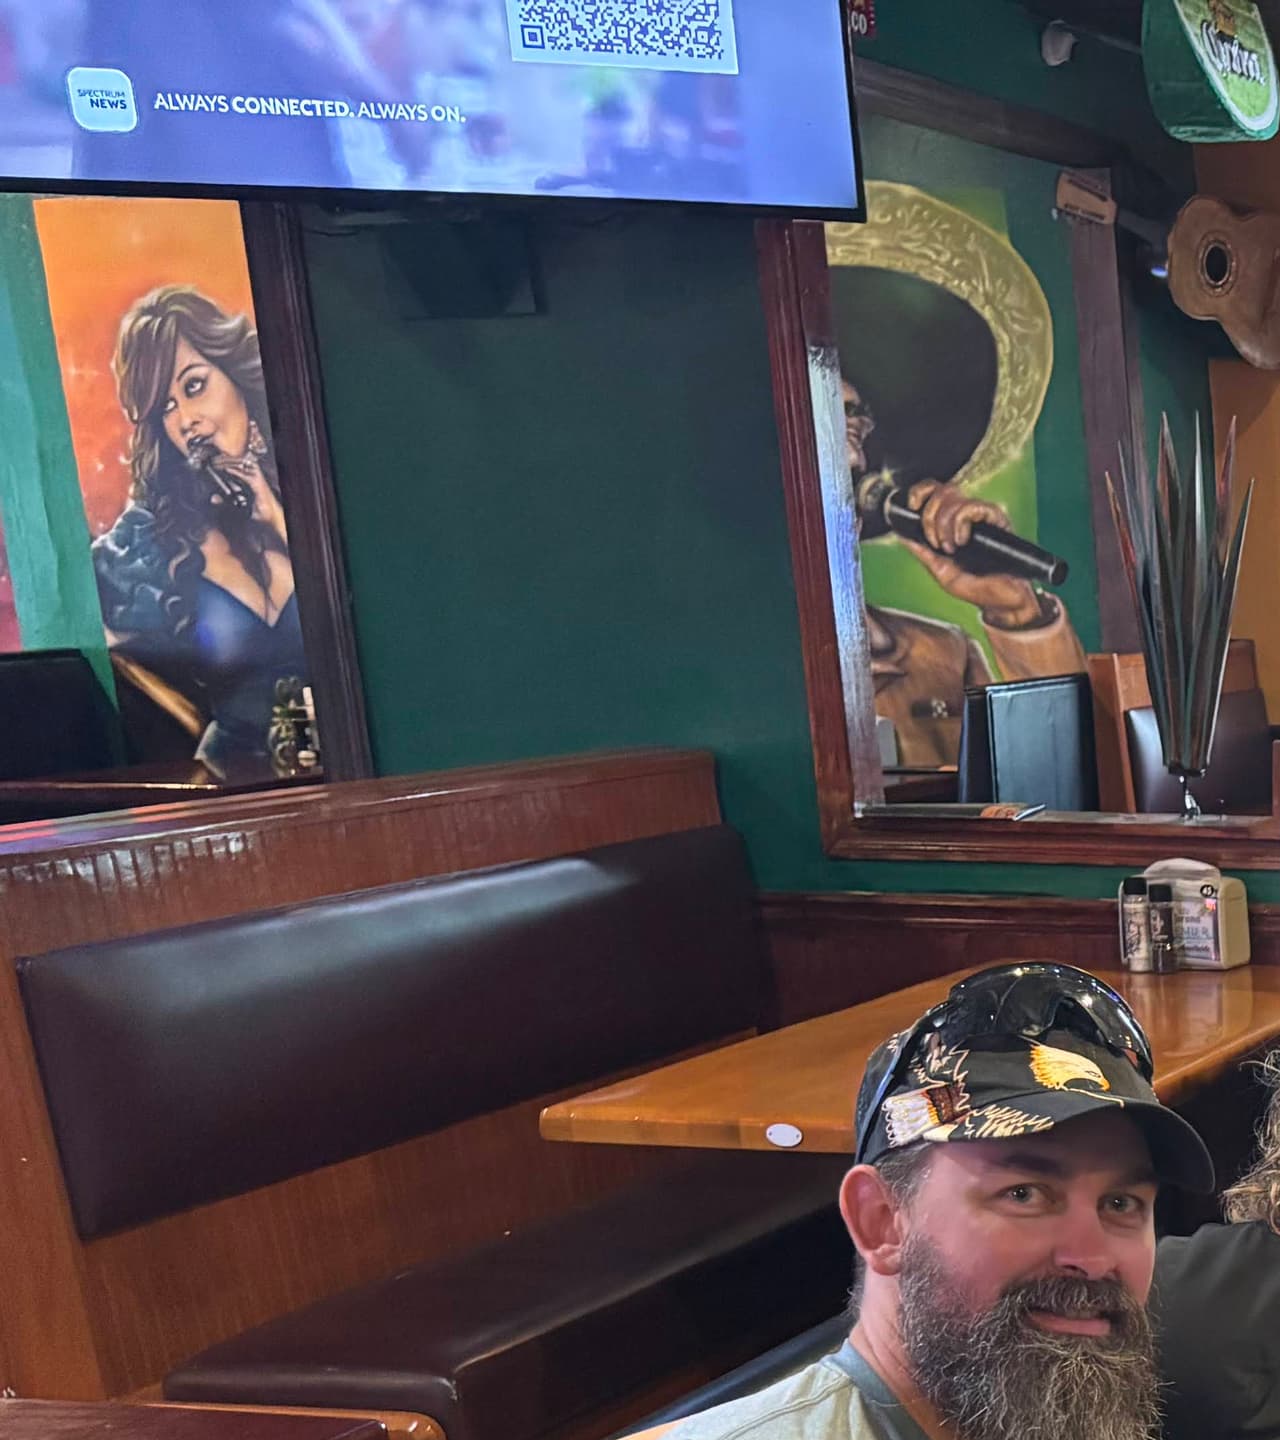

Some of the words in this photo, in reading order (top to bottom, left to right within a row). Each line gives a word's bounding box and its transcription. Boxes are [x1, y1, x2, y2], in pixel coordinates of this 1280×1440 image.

[77, 88, 126, 98] SPECTRUM
[90, 98, 127, 110] NEWS
[153, 92, 230, 113] ALWAYS
[231, 96, 355, 118] CONNECTED.
[357, 102, 428, 122] ALWAYS
[430, 105, 468, 123] ON.
